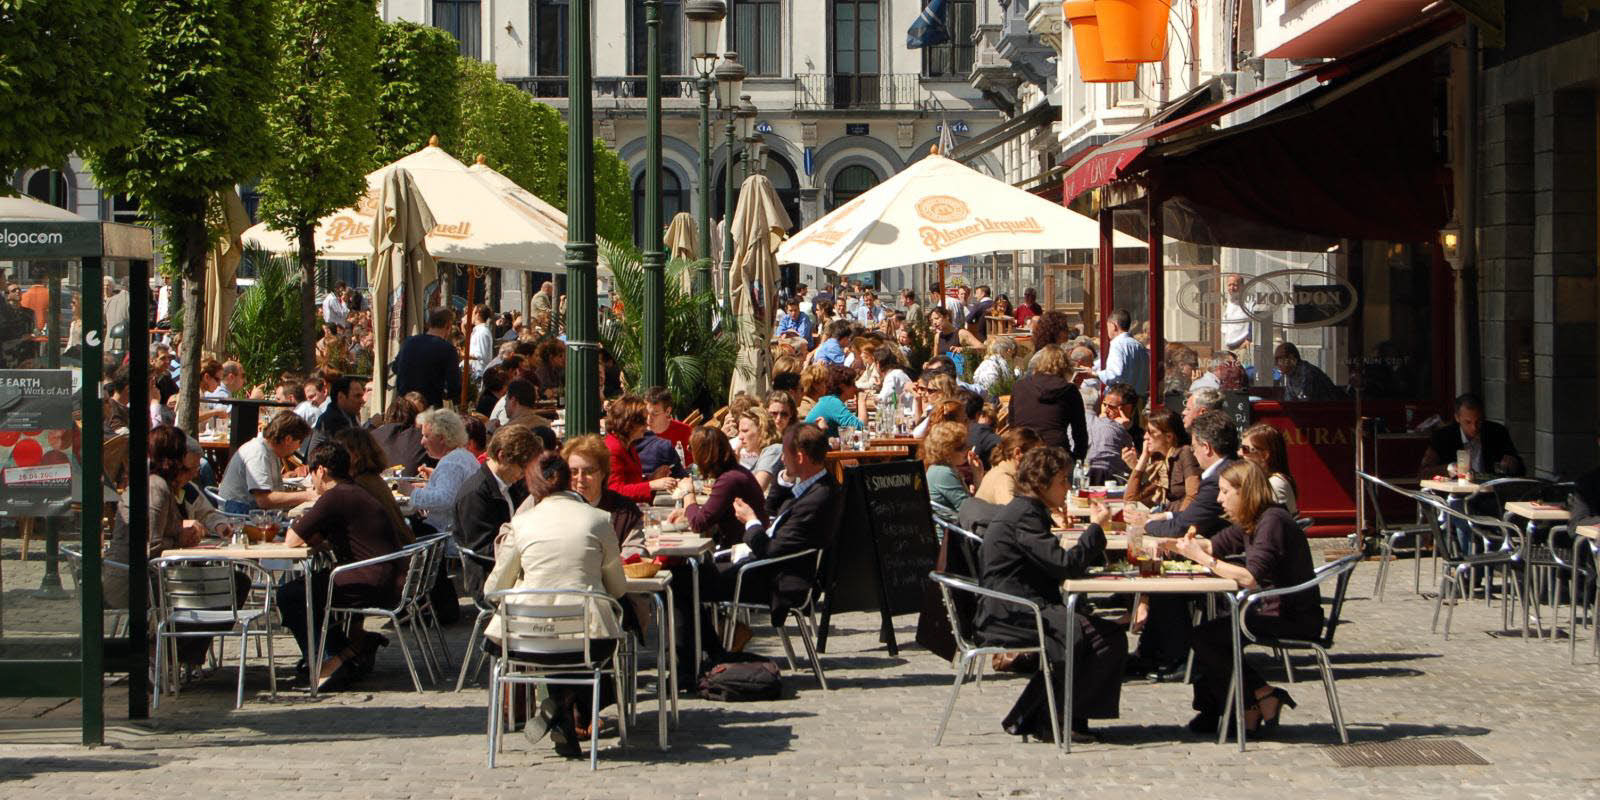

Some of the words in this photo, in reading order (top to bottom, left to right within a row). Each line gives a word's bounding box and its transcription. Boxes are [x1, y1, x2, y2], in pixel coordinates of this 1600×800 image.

[326, 216, 369, 243] Pils
[428, 222, 472, 238] uell
[918, 222, 981, 252] Pilsner
[975, 217, 1044, 235] Urquell
[1255, 291, 1341, 306] LONDON
[7, 378, 40, 388] EARTH
[24, 386, 45, 395] Work
[57, 387, 69, 395] Art
[872, 474, 912, 491] STRONGBOW
